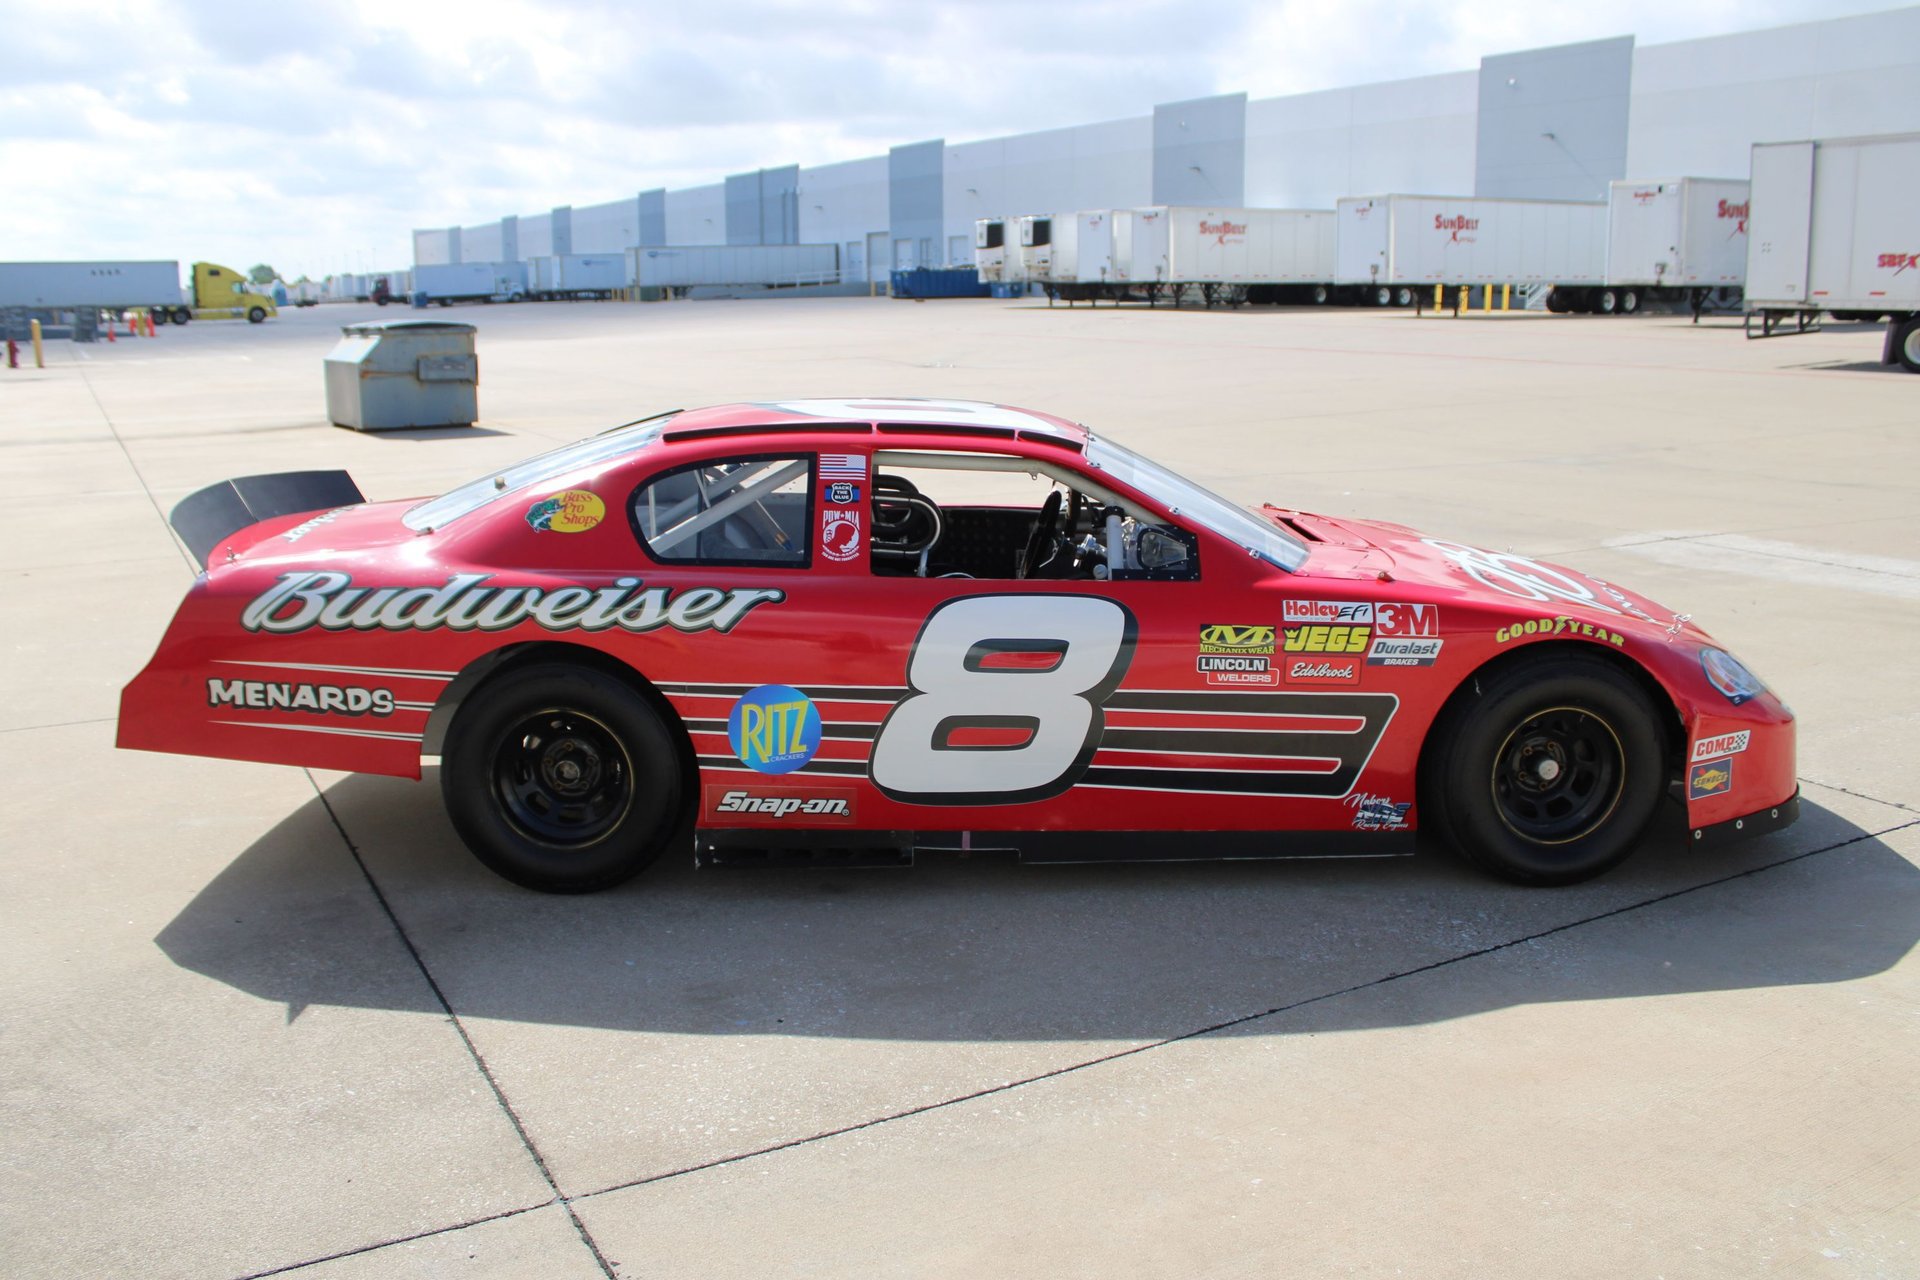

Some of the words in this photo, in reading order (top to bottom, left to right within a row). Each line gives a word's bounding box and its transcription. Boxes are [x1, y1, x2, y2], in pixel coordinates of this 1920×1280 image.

[563, 492, 593, 503] Bass
[563, 503, 585, 513] Pro
[561, 514, 600, 527] Shops
[823, 510, 840, 529] POW
[845, 510, 860, 530] MIA
[241, 570, 786, 634] Budweiser
[1285, 600, 1339, 621] Holley
[1337, 605, 1370, 621] EFI
[1377, 604, 1437, 635] 3M
[1284, 625, 1371, 652] JEGS
[1495, 615, 1625, 647] GOODYEAR
[1200, 644, 1247, 654] MECHANIX
[1248, 645, 1275, 654] WEAR
[1374, 641, 1438, 655] Duralast
[1201, 658, 1265, 671] LINCOLN
[1291, 662, 1352, 679] Edelbrock
[1383, 658, 1419, 666] BRAKES
[1217, 673, 1272, 683] WELDERS
[207, 678, 395, 717] MENARDS
[866, 591, 1139, 807] 8
[741, 700, 809, 763] RITZ
[1696, 736, 1735, 757] COMP
[770, 752, 805, 763] CRACKERS
[716, 791, 848, 817] Snap-on
